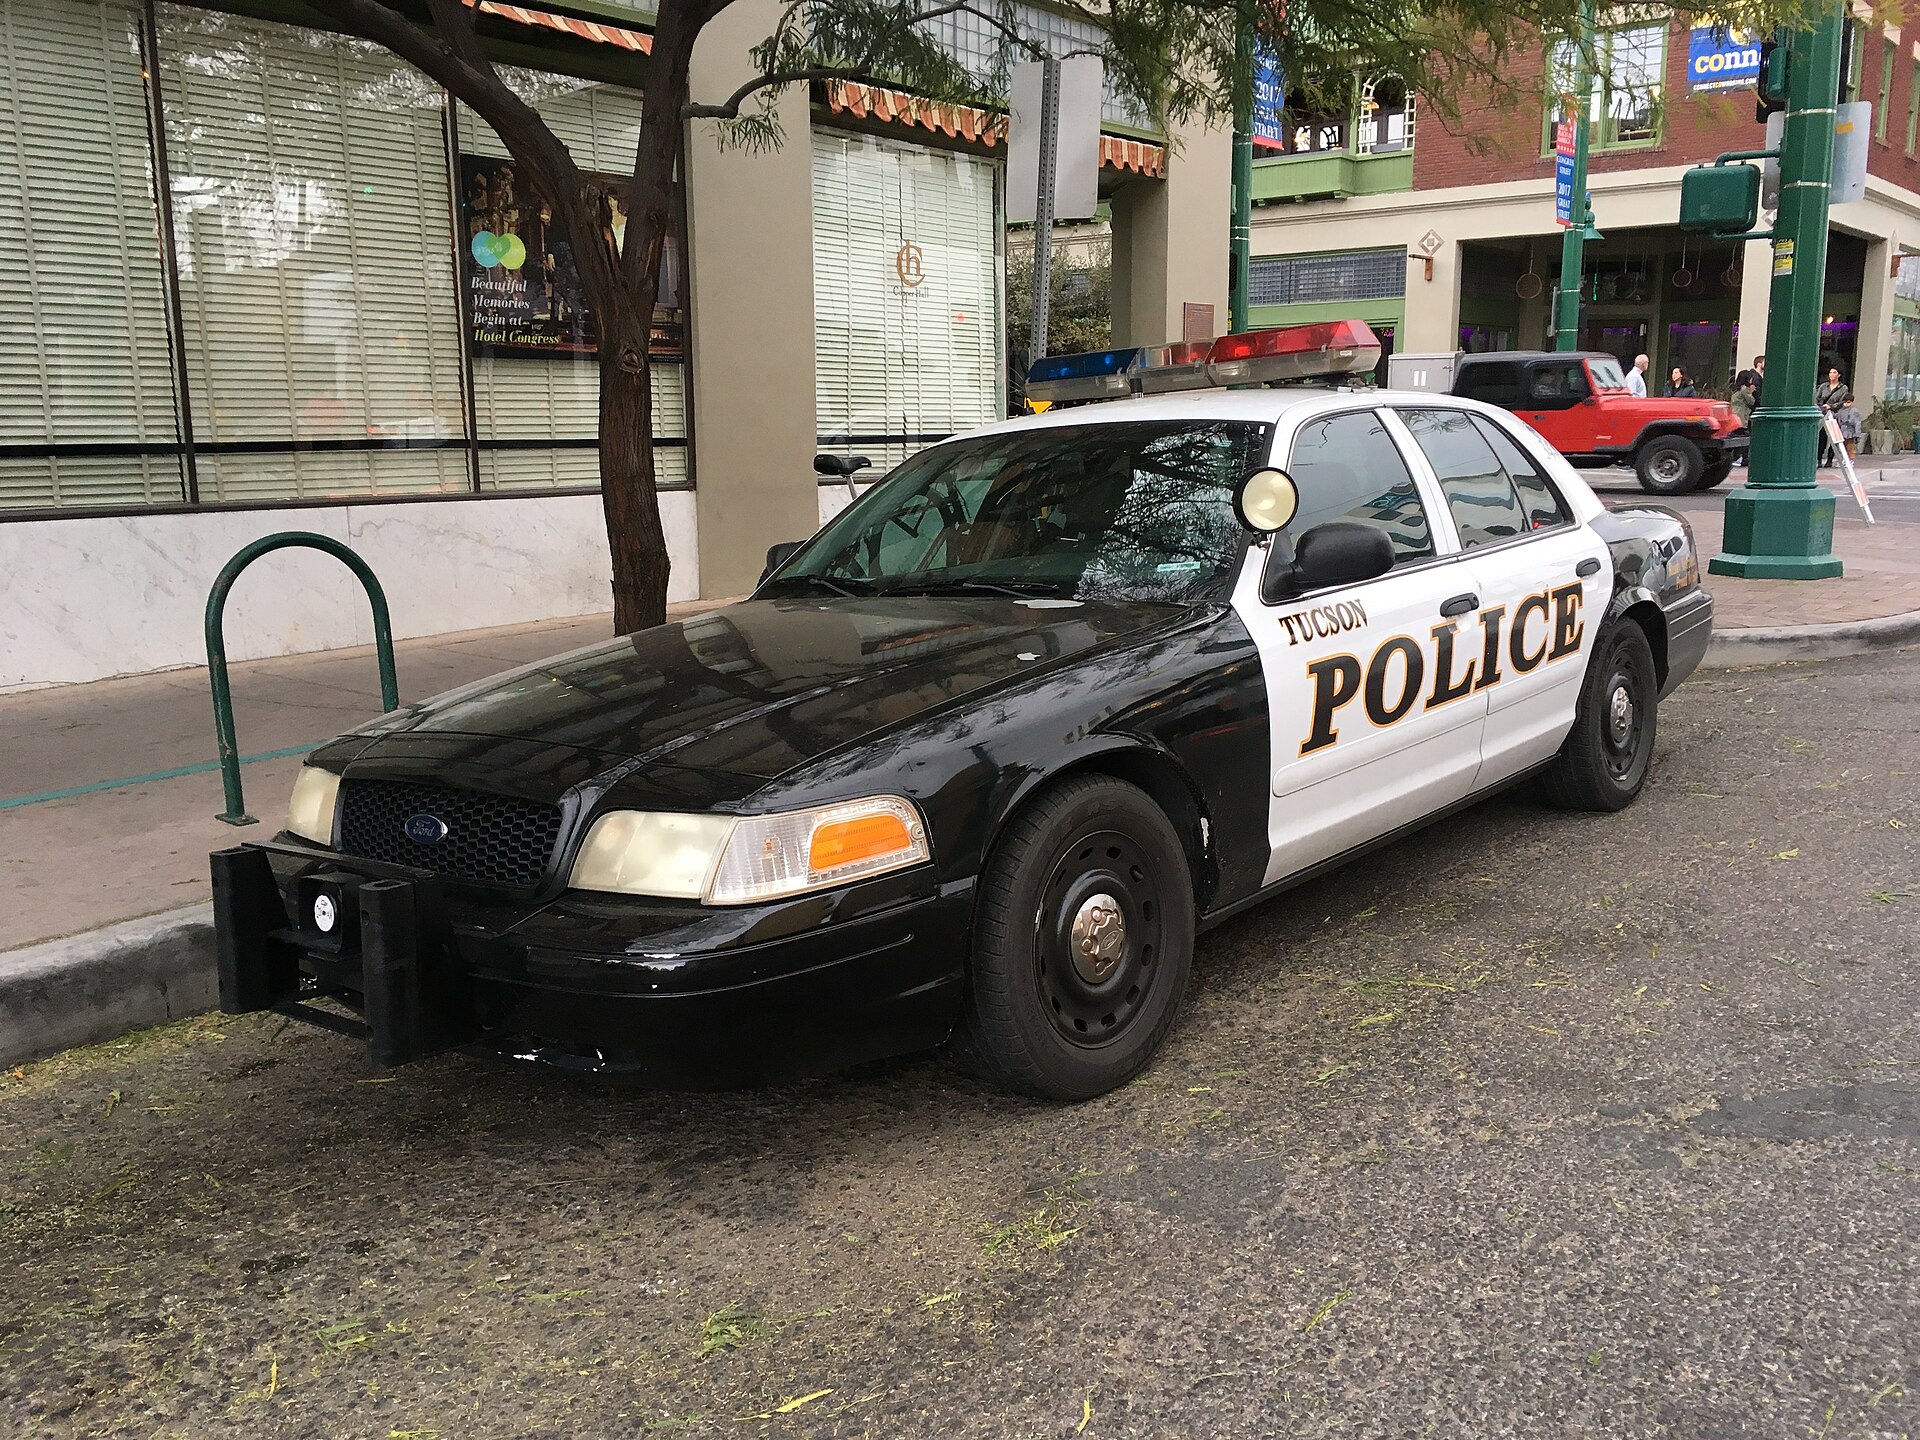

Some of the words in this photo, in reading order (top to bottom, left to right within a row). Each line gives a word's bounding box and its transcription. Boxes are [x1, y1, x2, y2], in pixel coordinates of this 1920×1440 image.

[1694, 49, 1761, 73] conn
[1256, 81, 1282, 103] 2017
[1558, 182, 1571, 197] 2017
[471, 277, 527, 293] Beautiful
[473, 294, 530, 309] Memories
[473, 312, 506, 328] Begin
[474, 329, 506, 342] Hotel
[509, 331, 560, 347] Congress
[1278, 598, 1369, 647] TUCSON
[1297, 582, 1585, 758] POLICE
[412, 820, 436, 837] Ford
